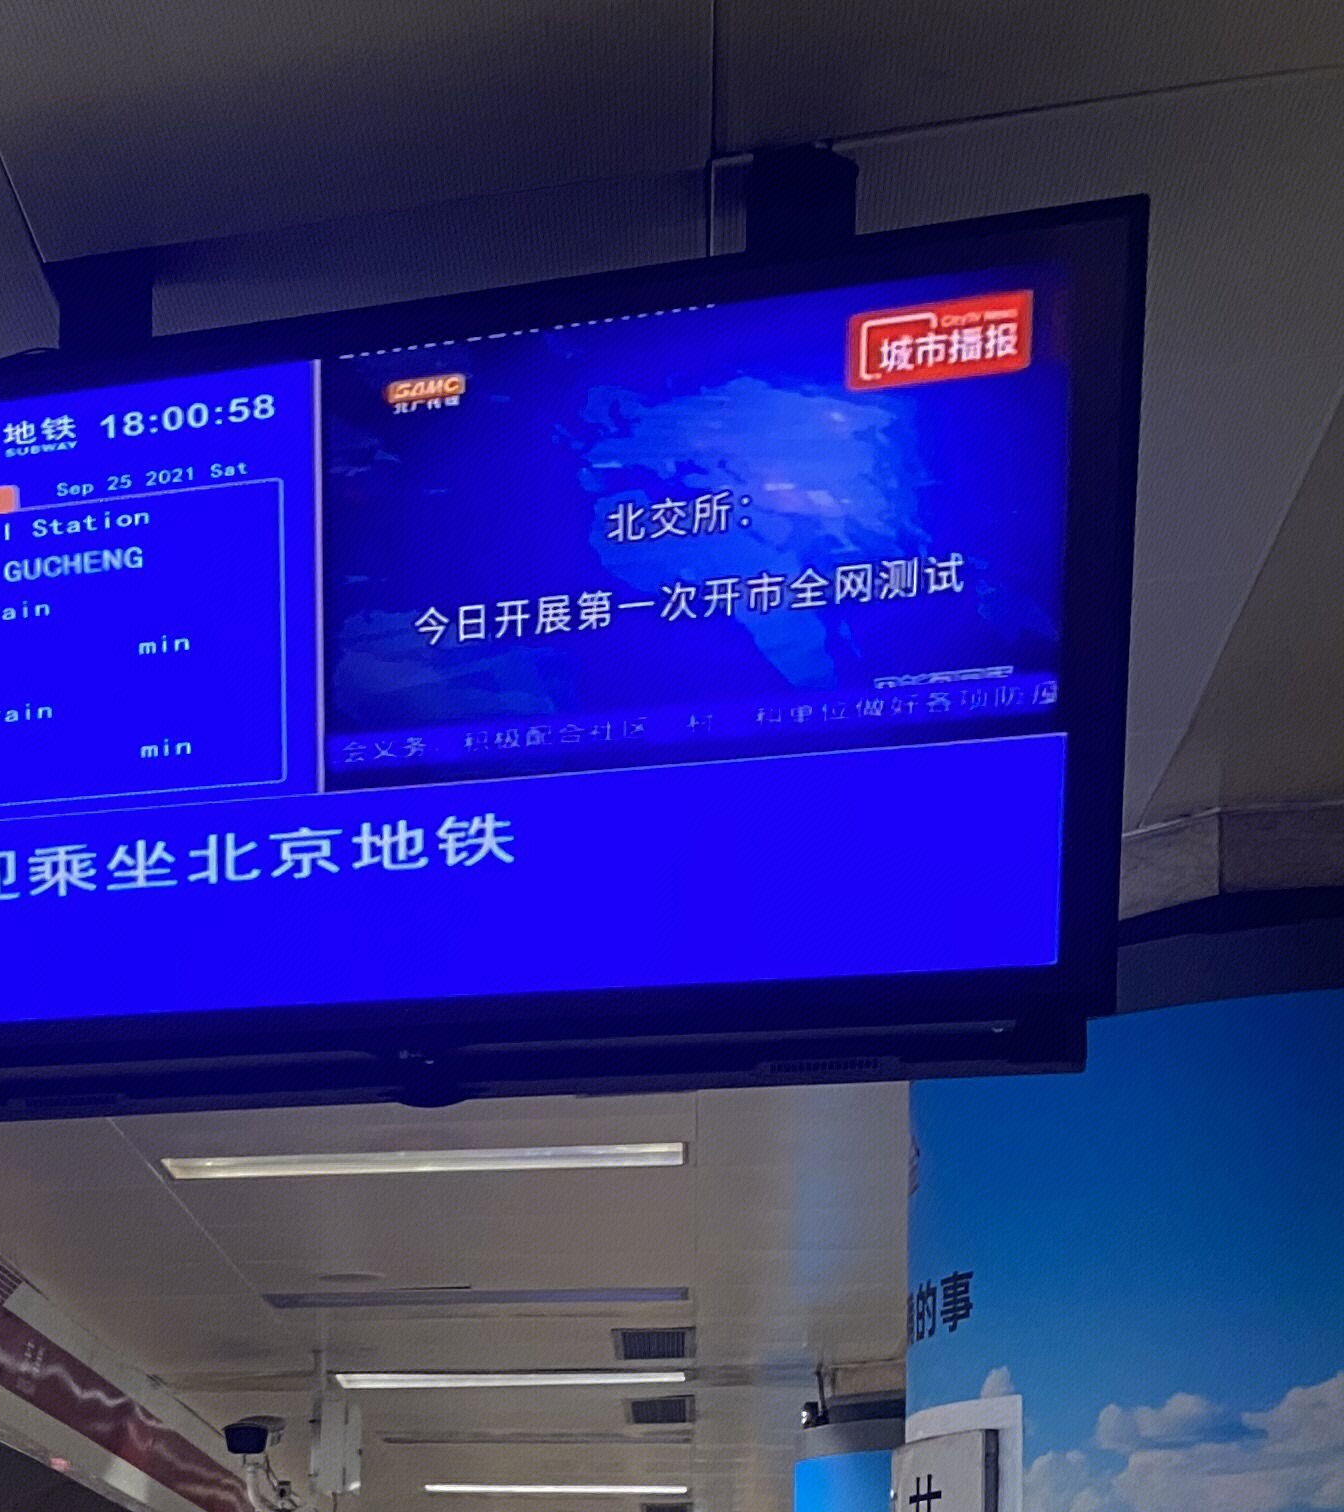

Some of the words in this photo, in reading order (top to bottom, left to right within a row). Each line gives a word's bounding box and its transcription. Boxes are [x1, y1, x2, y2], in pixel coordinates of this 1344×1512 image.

[879, 322, 1018, 372] 城市播报
[100, 394, 275, 439] 18:00:58
[5, 441, 78, 458] SUBWAY
[56, 482, 94, 497] Sep
[107, 474, 132, 491] 25
[145, 466, 194, 487] 2021
[210, 462, 248, 479] Sat
[32, 511, 150, 538] Station
[3, 546, 143, 583] GUCHENG
[414, 552, 965, 647] 今日开展第一次开市全网测试
[138, 634, 190, 656] min
[141, 737, 192, 759] min
